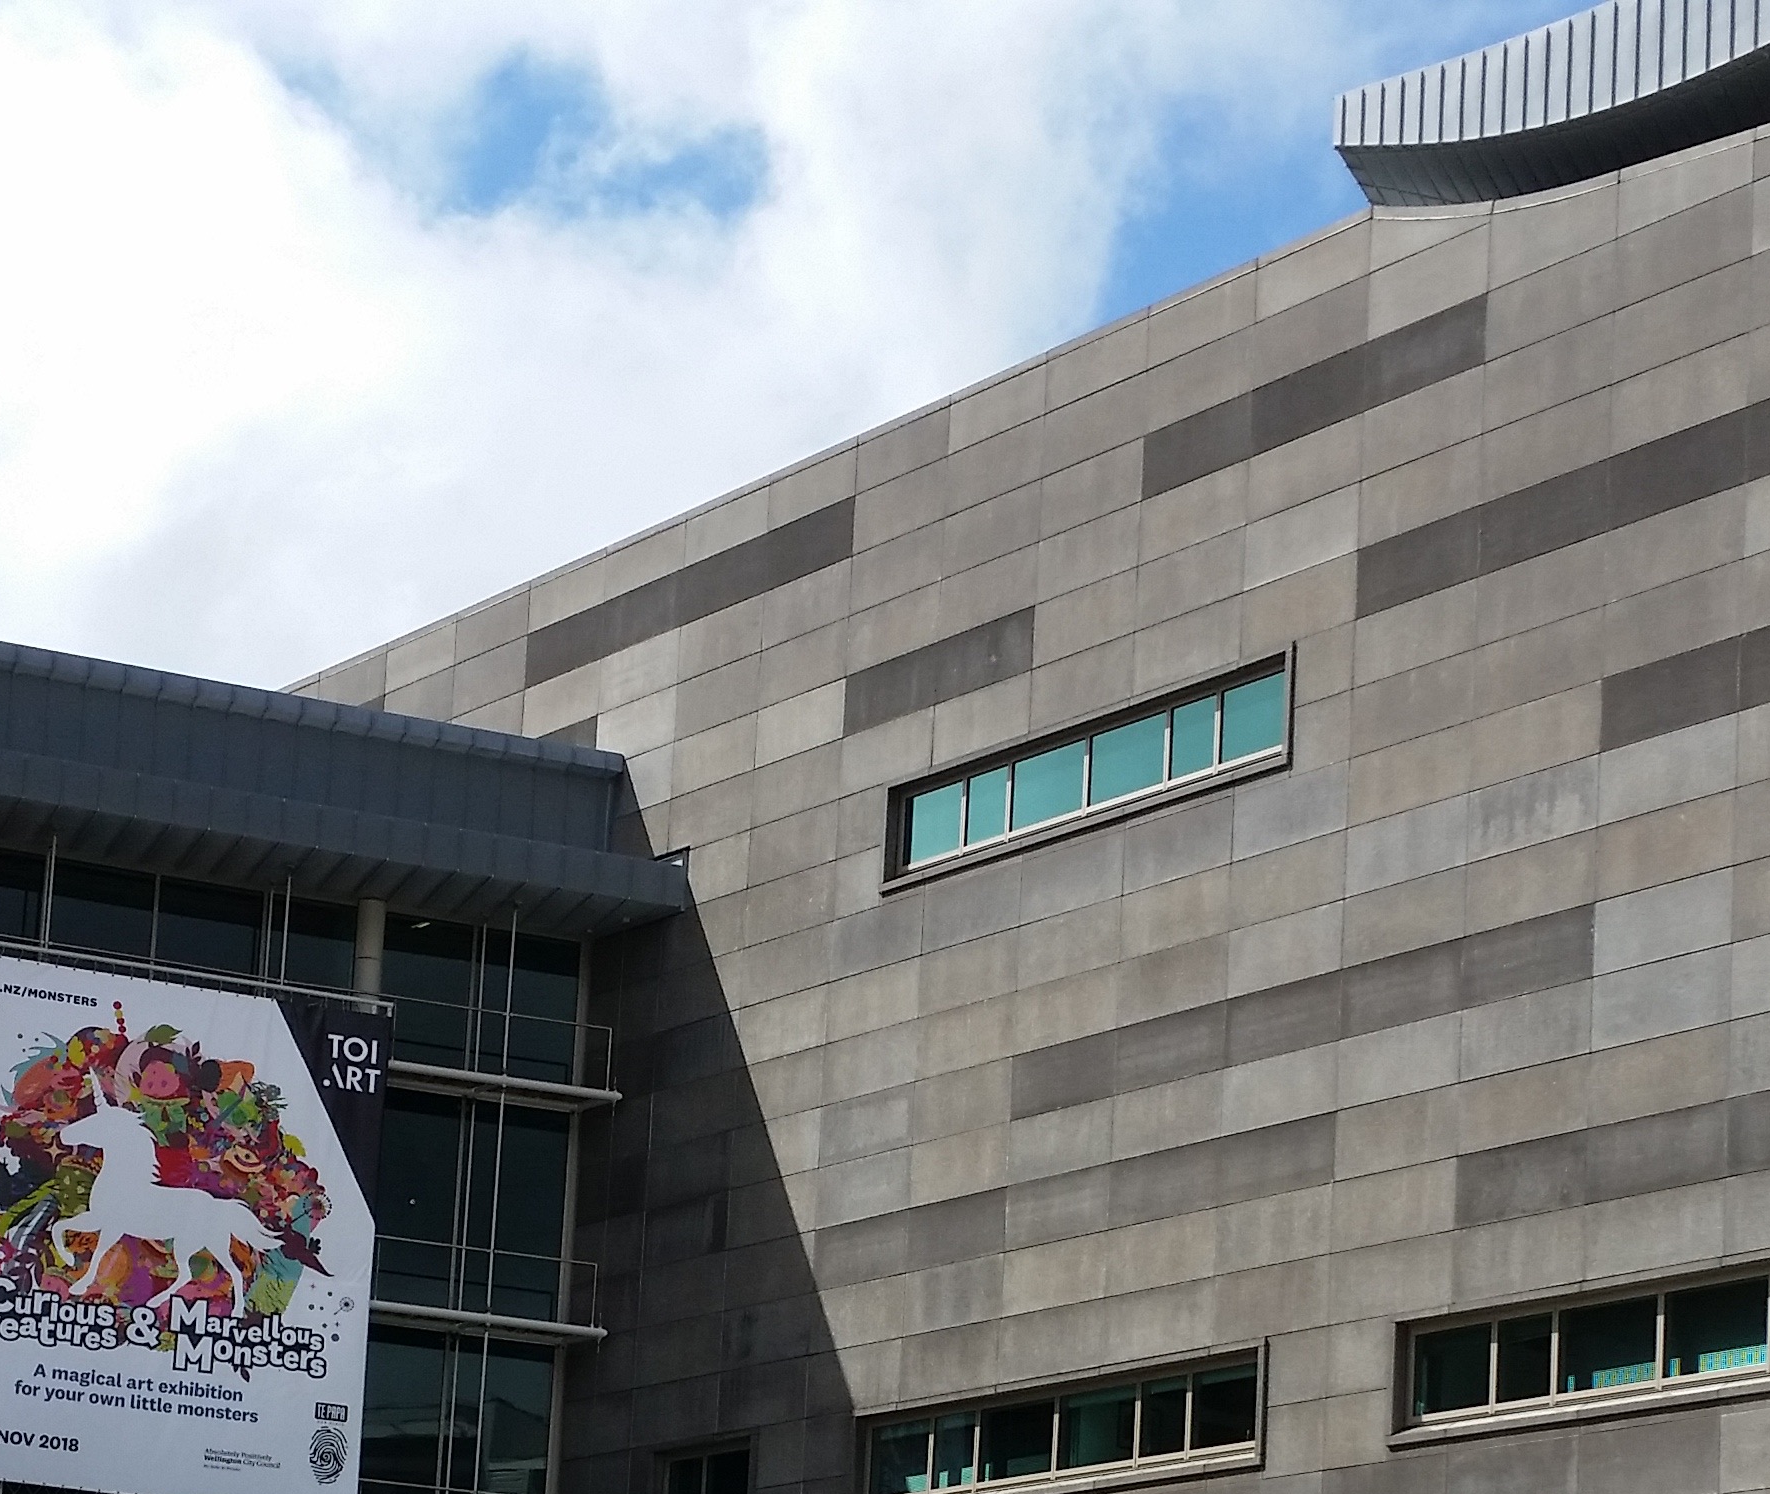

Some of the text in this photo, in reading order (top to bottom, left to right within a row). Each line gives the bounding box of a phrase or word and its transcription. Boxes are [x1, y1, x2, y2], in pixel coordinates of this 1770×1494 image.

[327, 1033, 378, 1065] TOI
[126, 1305, 161, 1348] &
[170, 1295, 325, 1351] Marvellous
[174, 1333, 327, 1378] Monsters
[14, 1380, 259, 1423] for your own little monsters
[33, 1363, 243, 1402] A magical art exhibition
[317, 1403, 326, 1419] TE
[38, 1434, 80, 1452] 2018
